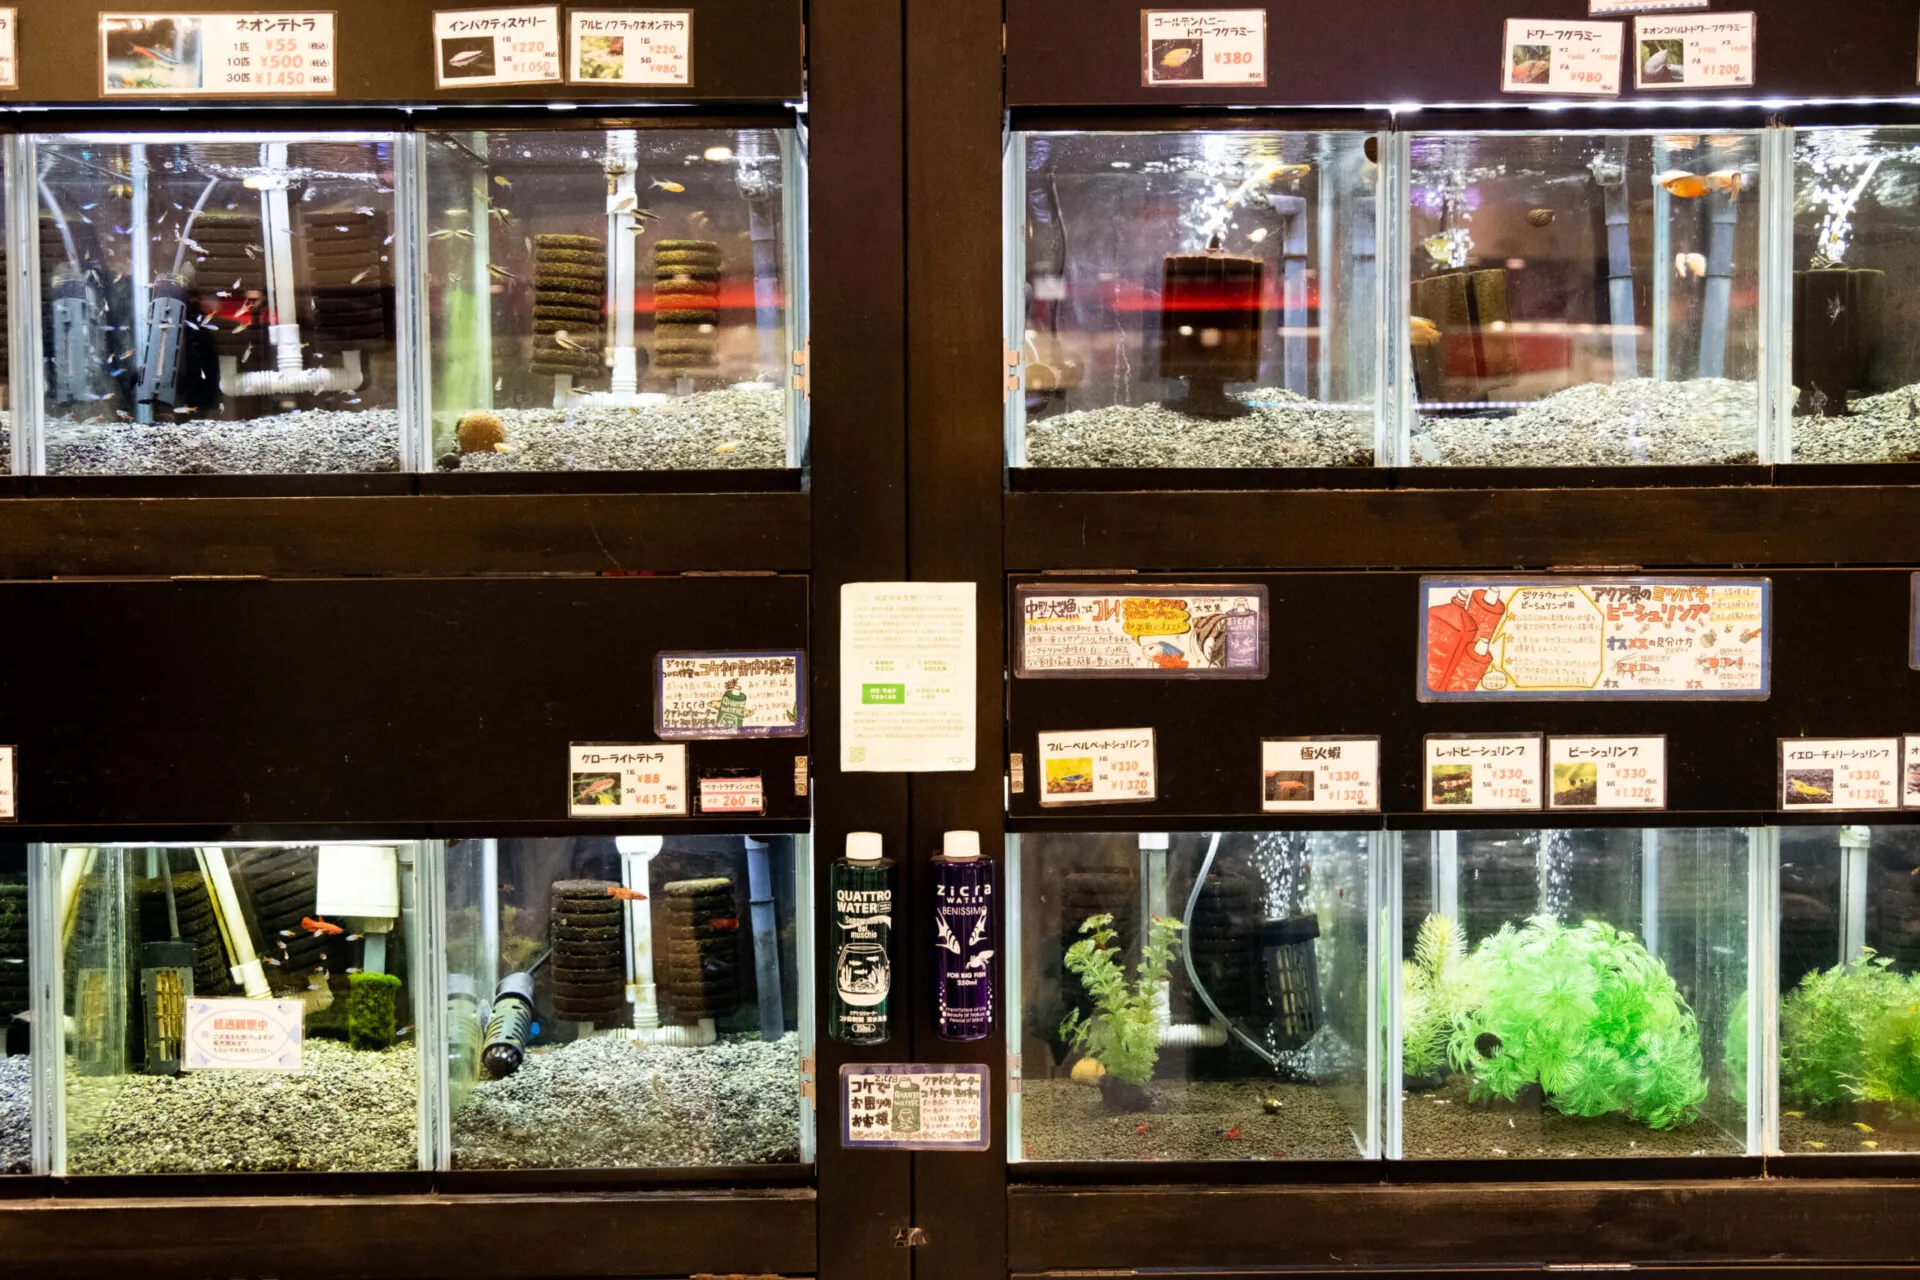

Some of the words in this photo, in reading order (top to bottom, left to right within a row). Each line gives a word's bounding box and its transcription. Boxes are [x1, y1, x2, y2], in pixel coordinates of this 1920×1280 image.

[236, 18, 315, 32] ネオンテトラ
[580, 20, 684, 30] アルビノブラックネオンテトラ
[1154, 17, 1226, 26] ゴールデンハニー
[1188, 27, 1256, 37] ドワーフグラミー
[1527, 29, 1602, 41] ドワーフグラミー
[234, 42, 249, 51] 1匹
[266, 38, 297, 51] ¥55
[512, 42, 544, 53] ¥220
[650, 46, 675, 54] ¥220
[228, 57, 250, 66] 10匹
[261, 55, 303, 68] ¥500
[1214, 52, 1252, 64] ¥380
[650, 65, 676, 73] ¥980
[227, 73, 250, 82] 30匹
[1570, 72, 1602, 83] ¥980
[1607, 603, 1710, 622] ビーシュリンプ
[1604, 679, 1619, 688] オス
[1686, 680, 1703, 689] メス
[673, 701, 705, 709] zicra
[1047, 739, 1150, 751] ブルーベルベットシュリンプ
[1436, 746, 1525, 757] レッドビーシュリンプ
[1569, 746, 1638, 758] ビーシュリンプ
[1789, 749, 1890, 760] イエローチェリーシュリンプ
[582, 753, 664, 764] グローライトテトラ
[1111, 761, 1138, 772] ¥330
[636, 773, 660, 784] ¥88
[1329, 770, 1359, 781] ¥330
[1492, 769, 1523, 779] ¥330
[1616, 768, 1646, 779] ¥330
[1849, 770, 1880, 780] ¥330
[635, 794, 667, 805] ¥415
[723, 795, 745, 806] 260
[752, 797, 759, 805] 円
[837, 890, 891, 901] QUATTRO
[937, 884, 991, 896] zicra
[837, 901, 878, 914] WATER
[875, 1075, 898, 1083] zicra
[851, 1078, 890, 1094] コケで
[852, 1096, 892, 1110] お困りの
[852, 1111, 889, 1128] お客様
